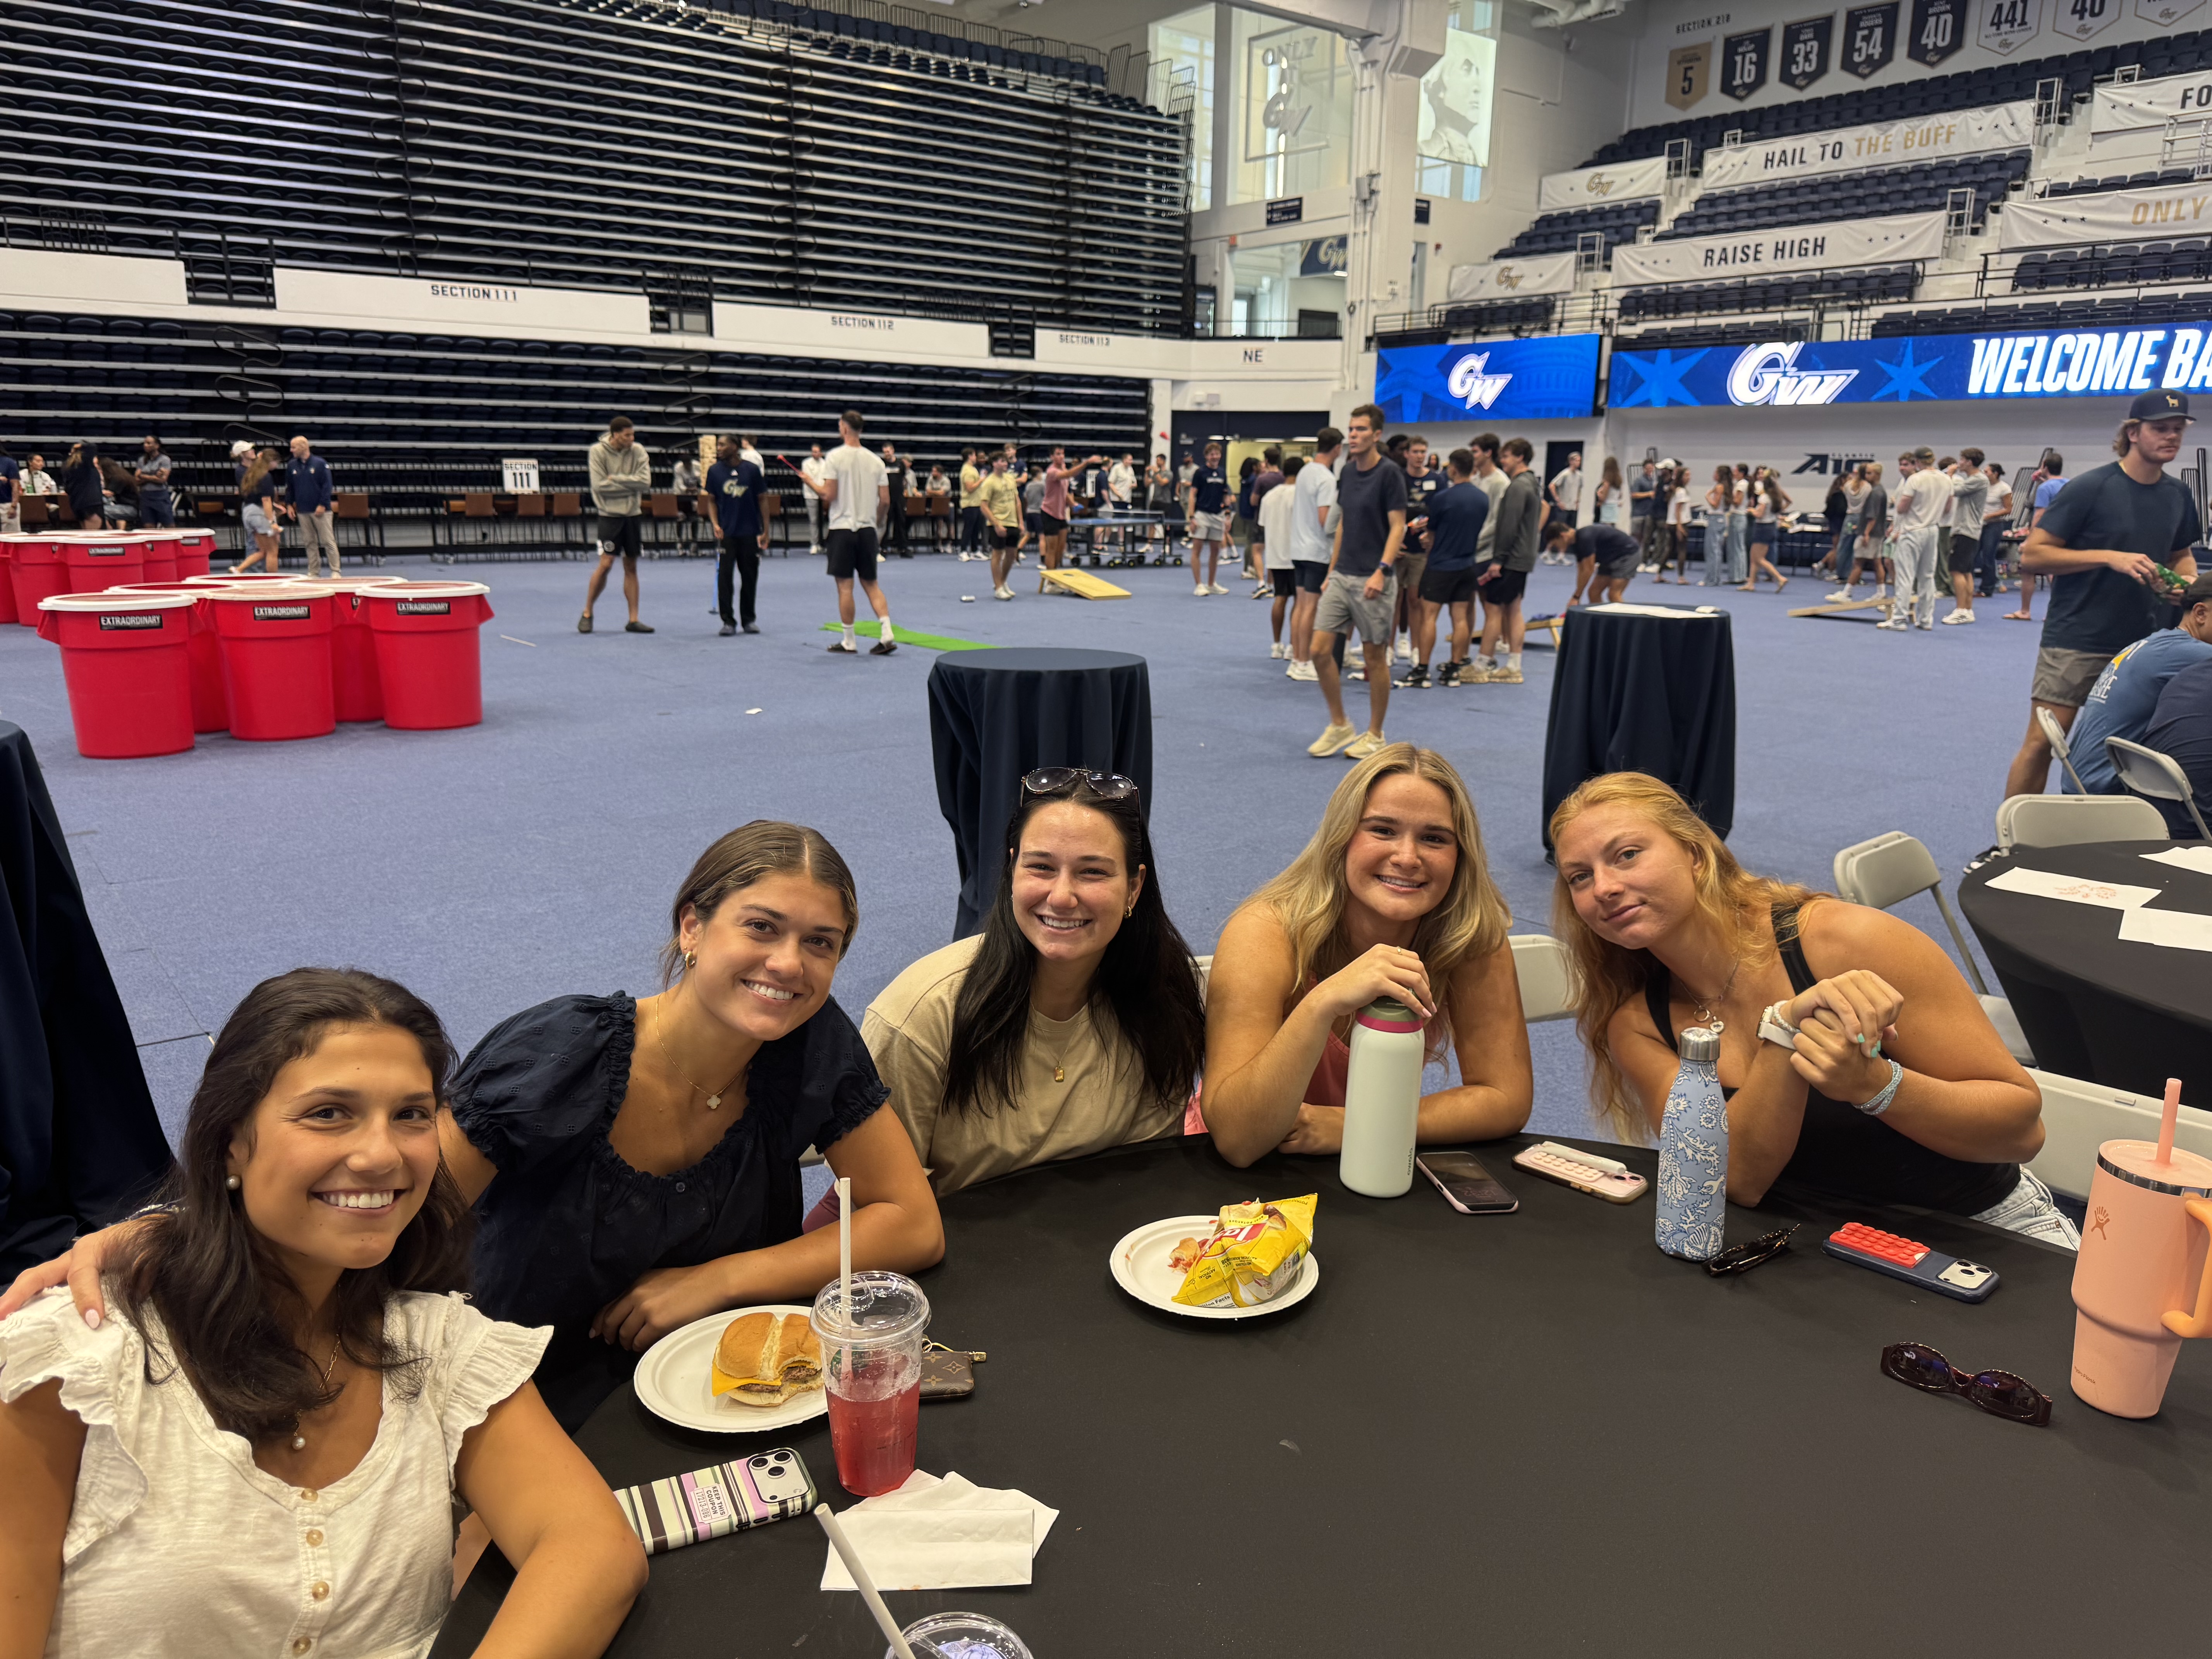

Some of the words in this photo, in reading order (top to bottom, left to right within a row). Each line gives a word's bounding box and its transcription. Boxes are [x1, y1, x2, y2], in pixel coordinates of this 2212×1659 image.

[1676, 18, 1712, 34] SECTION
[1989, 0, 2028, 31] 441
[1852, 27, 1883, 62] 54
[1920, 13, 1953, 50] 40
[1732, 52, 1757, 86] 16
[1790, 40, 1819, 75] 33
[1681, 66, 1694, 96] 5
[1764, 146, 1806, 170] HAIL
[1819, 141, 1843, 161] TO
[1855, 134, 1893, 156] THE
[1903, 124, 1956, 150] BUFF
[2131, 196, 2208, 225] ONLY
[1704, 243, 1764, 268] RAISE
[1774, 236, 1826, 260] HIGH
[431, 285, 491, 300] SECTION
[495, 290, 517, 301] 111
[831, 316, 875, 329] SECTION
[878, 319, 894, 330] 112
[1059, 334, 1095, 345] SECTION
[1242, 349, 1263, 362] NE
[1968, 330, 2166, 394] WELCOME
[1448, 351, 1513, 410] GW
[1726, 341, 1860, 406] GW
[505, 463, 537, 471] SECTION
[513, 472, 531, 488] 111
[100, 615, 161, 626] EXTRAORDINARY
[255, 606, 308, 617] EXTRAORDINARY
[397, 602, 449, 611] EXTRAORDINARY
[1214, 1295, 1230, 1304] Facts
[706, 1490, 718, 1515] COUPON
[712, 1486, 721, 1501] KEEP
[717, 1501, 726, 1516] THIS
